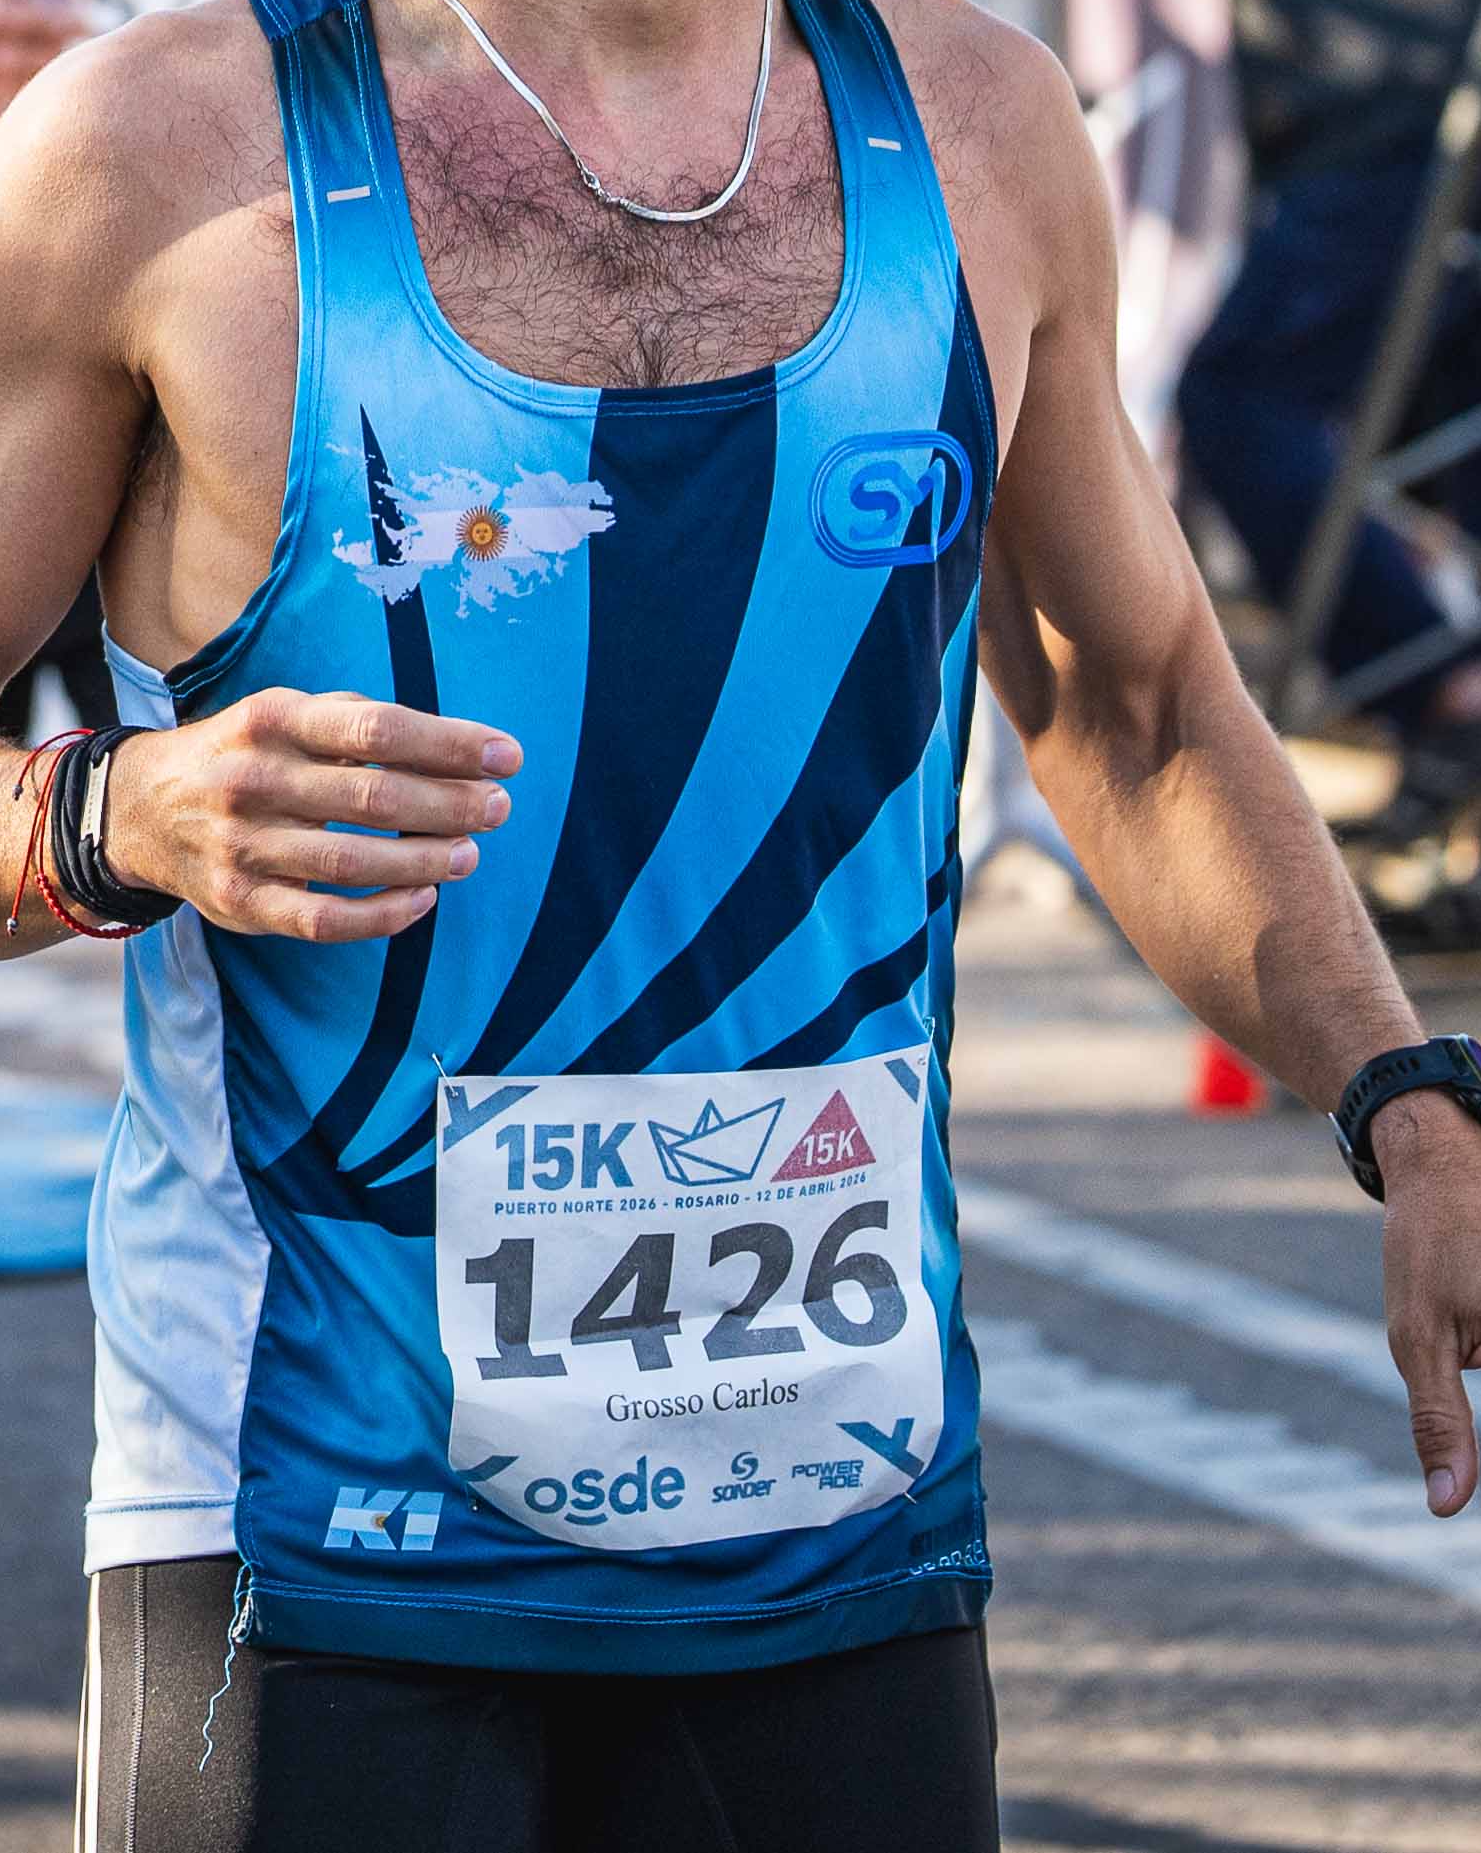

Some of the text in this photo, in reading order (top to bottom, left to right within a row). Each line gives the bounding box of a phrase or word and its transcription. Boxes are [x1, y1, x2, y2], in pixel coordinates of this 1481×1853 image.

[495, 1122, 637, 1191] 15K
[801, 1126, 858, 1168] 15K
[494, 1201, 557, 1215] PUERTO
[563, 1199, 614, 1214] NORTE
[619, 1197, 657, 1211] 2026
[675, 1193, 739, 1210] ROSARIO
[756, 1190, 772, 1202] 12
[777, 1186, 795, 1200] DE
[799, 1179, 837, 1198] ABRIL
[840, 1172, 868, 1191] 2026
[465, 1200, 908, 1381] 1426
[605, 1378, 800, 1423] Grosso Carlos
[523, 1455, 686, 1516] osde
[791, 1459, 864, 1479] POWER
